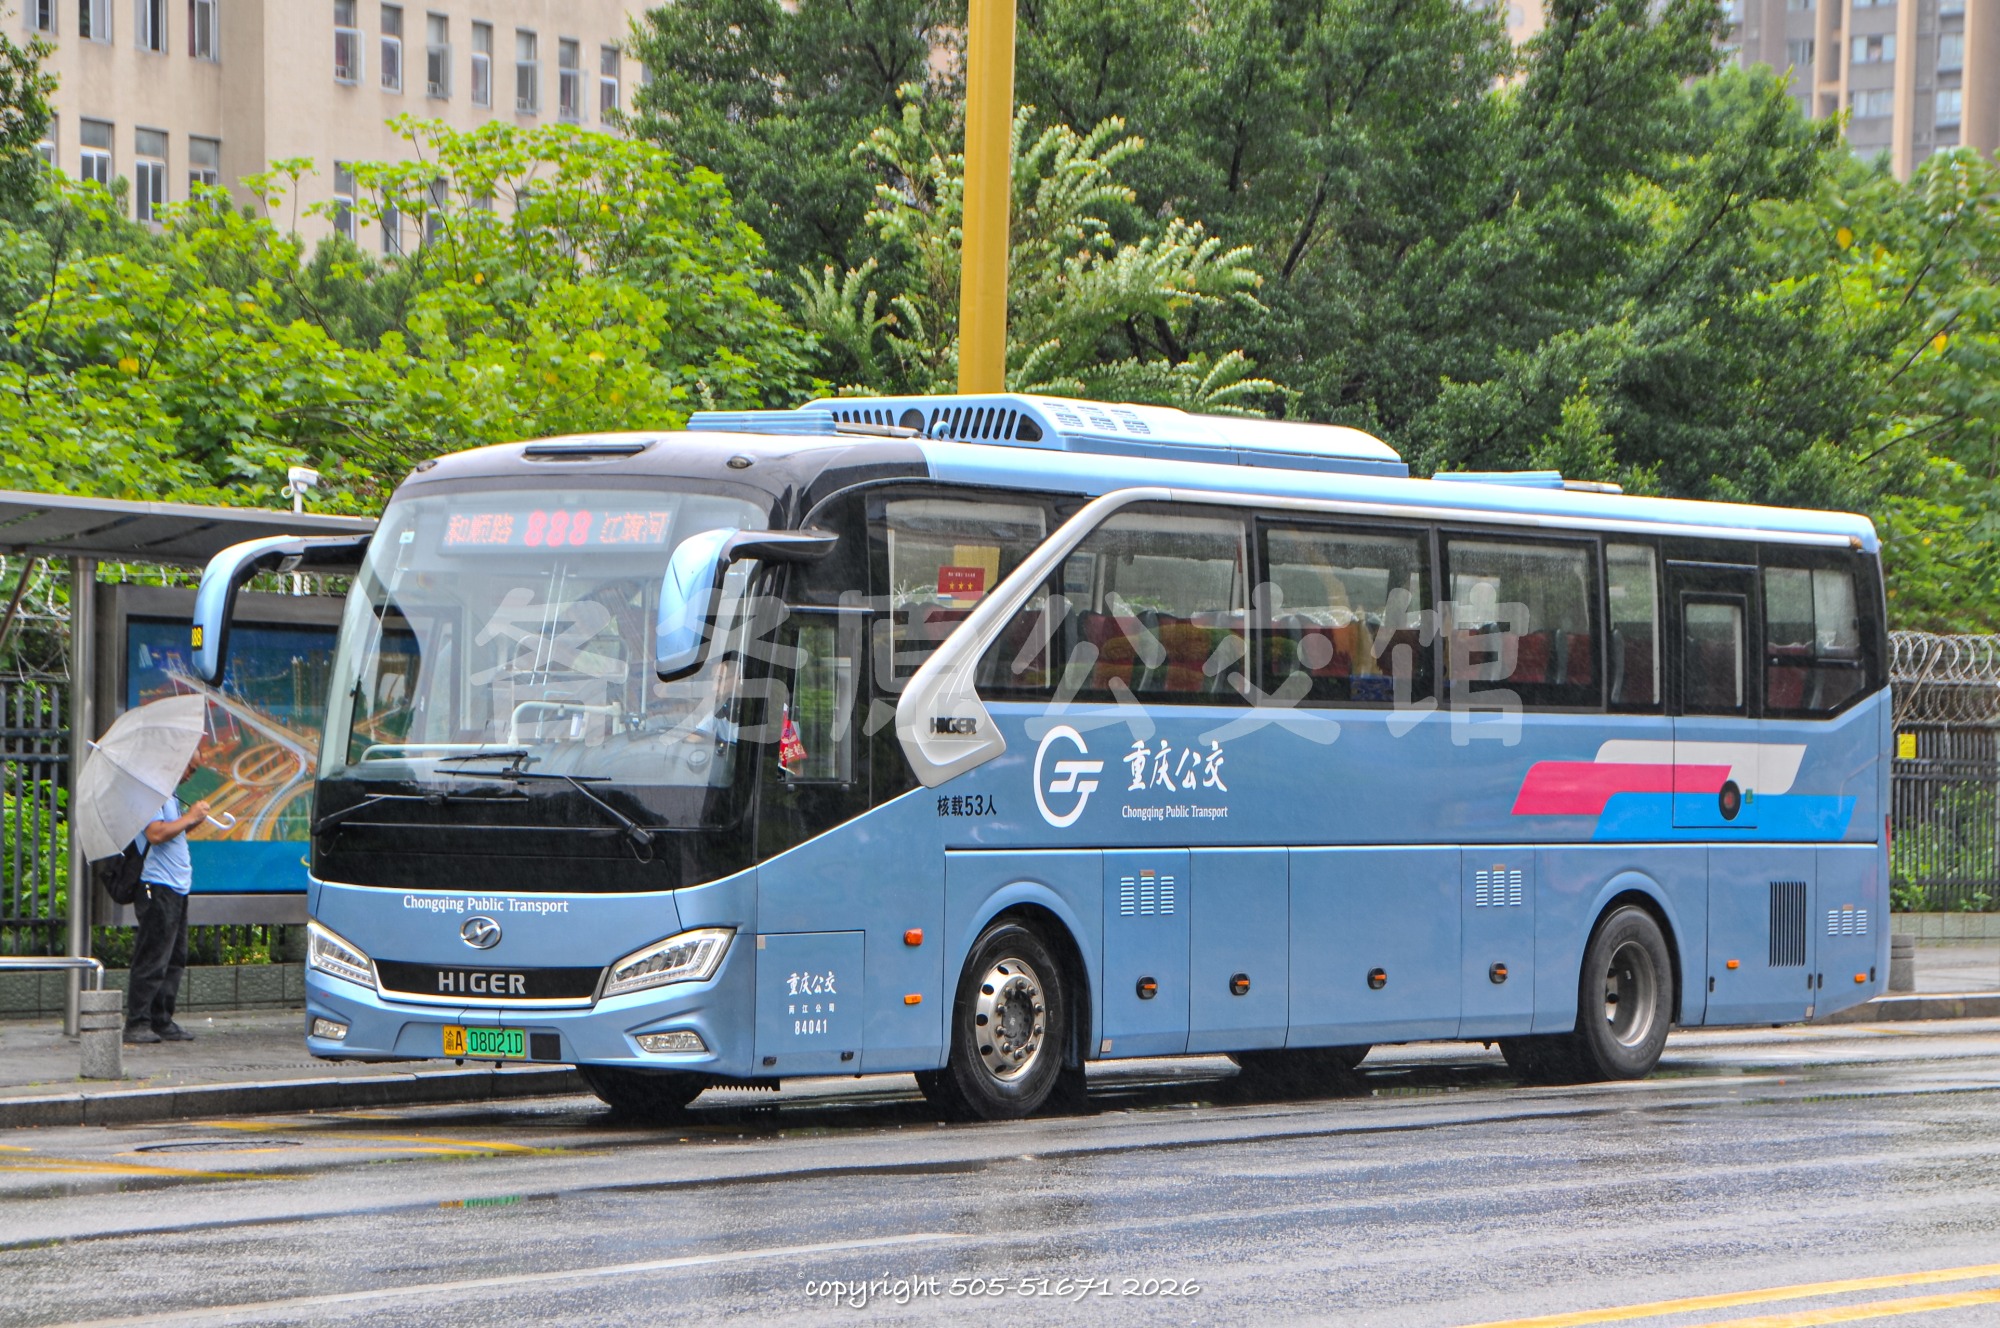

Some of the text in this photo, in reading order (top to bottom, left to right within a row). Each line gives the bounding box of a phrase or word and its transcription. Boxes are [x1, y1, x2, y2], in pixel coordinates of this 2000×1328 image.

[524, 509, 593, 547] 888
[930, 717, 977, 734] HIGER
[1123, 740, 1228, 792] 重庆公交
[937, 794, 997, 817] 核载53人
[1122, 805, 1228, 821] Chongqing Public Transport
[403, 895, 569, 915] Chongqing Public Transport
[438, 971, 526, 994] HIGER
[786, 970, 837, 996] 重庆公交
[795, 1019, 827, 1035] 84041
